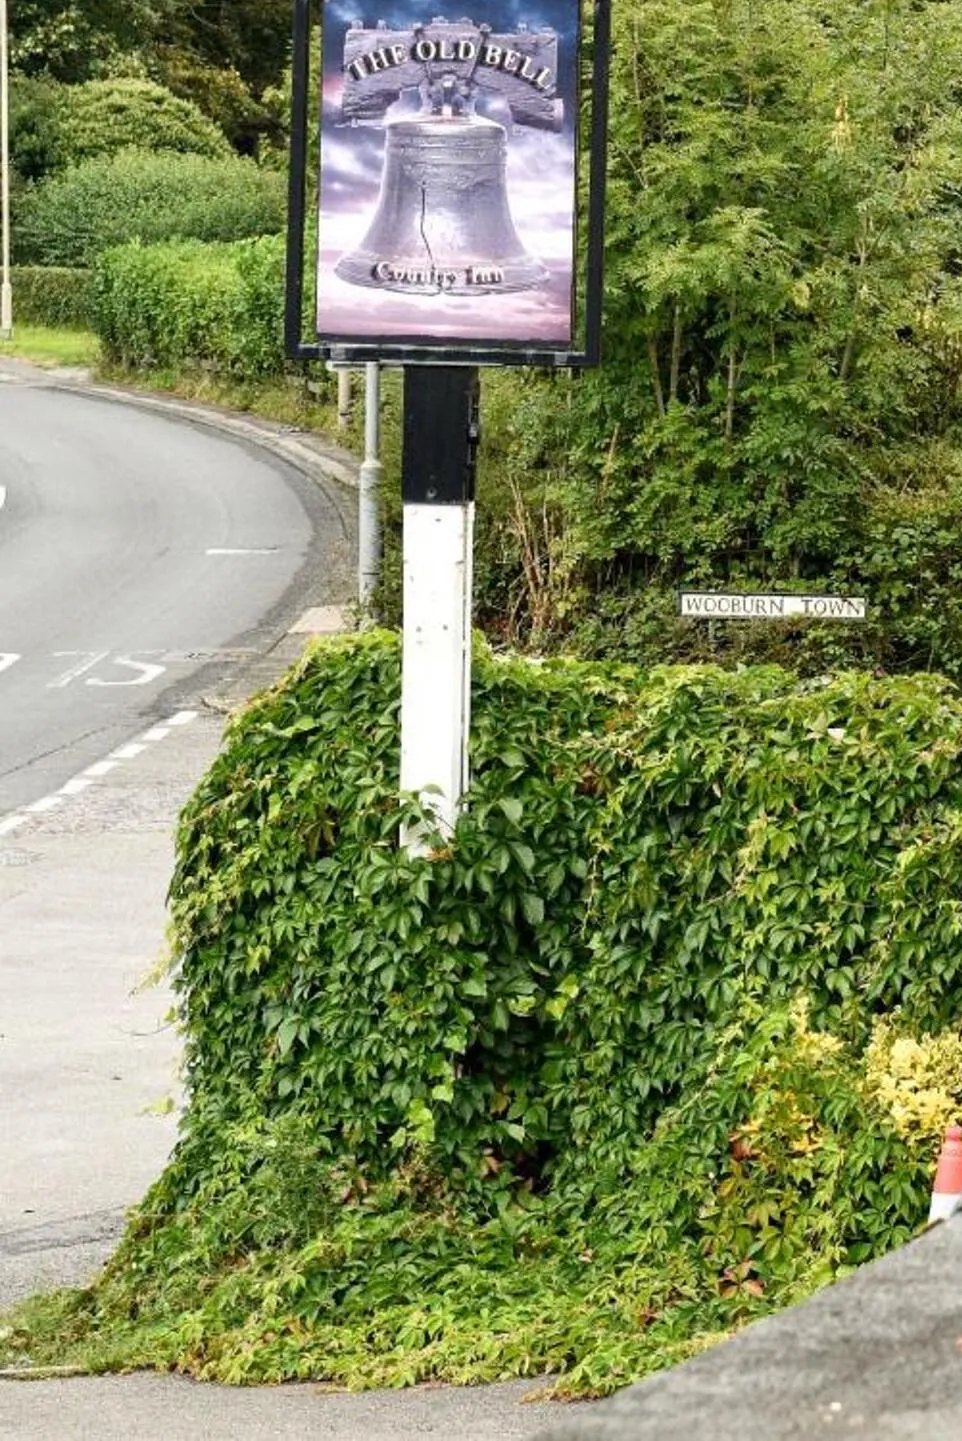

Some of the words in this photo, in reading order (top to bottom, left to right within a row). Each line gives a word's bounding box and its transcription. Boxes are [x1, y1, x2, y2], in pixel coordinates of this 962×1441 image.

[347, 44, 408, 79] THE
[415, 40, 476, 61] OLD
[485, 43, 552, 90] BELL
[686, 597, 784, 615] WOOBURN
[801, 599, 861, 615] TOWN
